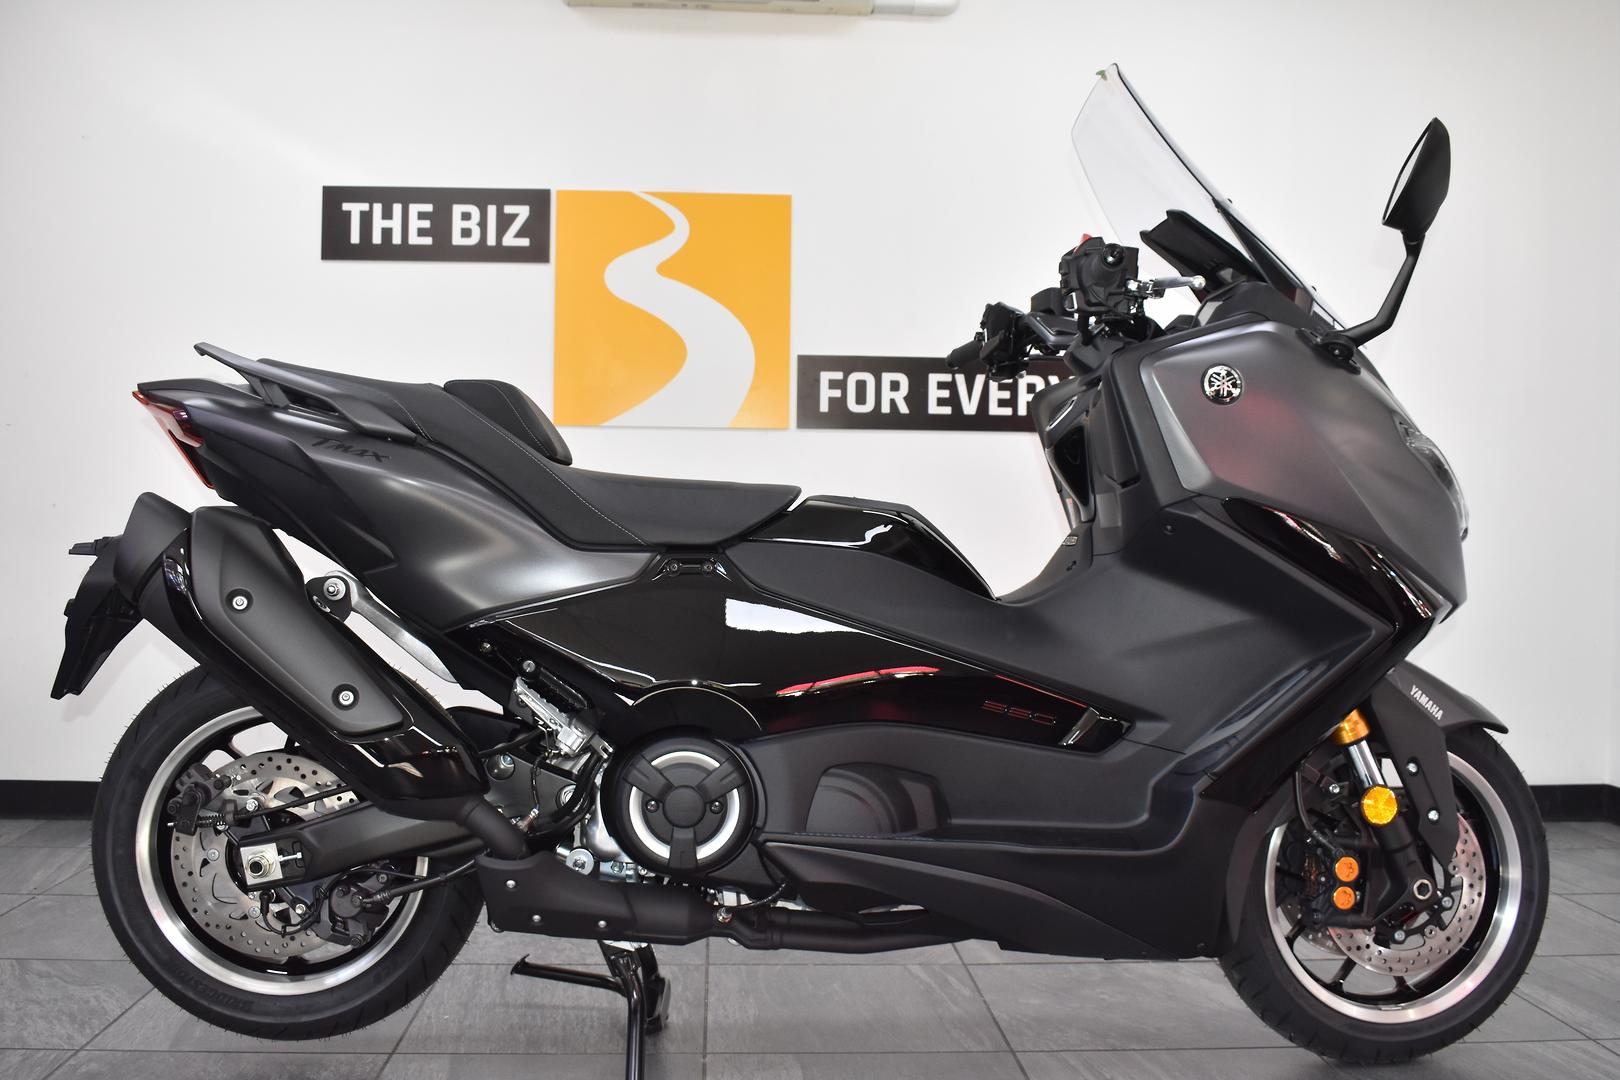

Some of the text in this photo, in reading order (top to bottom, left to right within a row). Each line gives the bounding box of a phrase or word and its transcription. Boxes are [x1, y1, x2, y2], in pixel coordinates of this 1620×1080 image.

[342, 202, 530, 246] THE BIZ
[819, 371, 1075, 416] FOR EVER
[1410, 684, 1443, 720] YAMAHA
